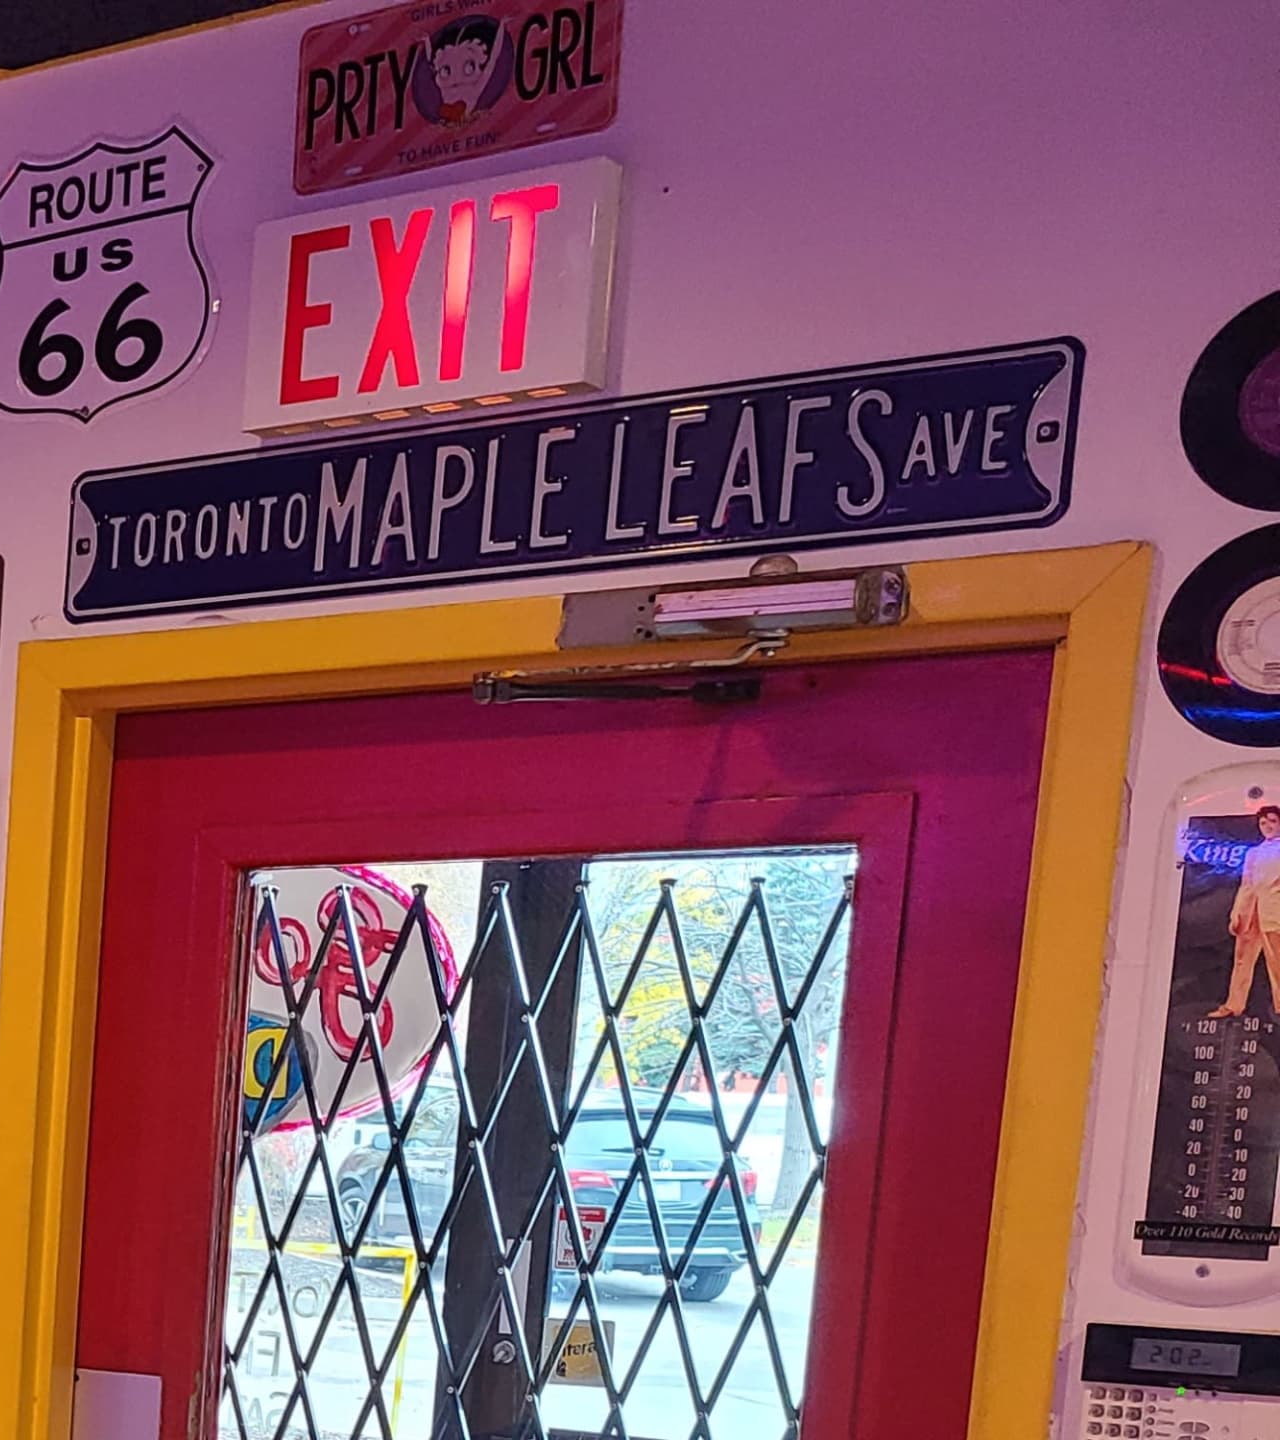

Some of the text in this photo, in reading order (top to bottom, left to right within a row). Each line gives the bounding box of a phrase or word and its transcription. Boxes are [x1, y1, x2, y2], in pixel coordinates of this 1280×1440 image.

[304, 2, 605, 150] PRTY GRL
[398, 150, 418, 163] TO
[422, 141, 460, 158] HAVE
[29, 155, 167, 228] ROUTE
[52, 238, 134, 282] US
[280, 183, 560, 405] EXIT
[19, 282, 164, 396] 66
[108, 388, 1013, 574] TORONTO MAPLE LEAFS AVE
[1198, 1021, 1217, 1033] 120
[1244, 1018, 1259, 1030] 50
[1194, 1047, 1214, 1059] 100
[1242, 1041, 1256, 1053] 40
[1240, 1064, 1253, 1077] 30
[1194, 1072, 1209, 1084] 80
[1237, 1086, 1251, 1099] 20
[1191, 1096, 1206, 1109] 60
[1236, 1108, 1248, 1120] 10
[1189, 1119, 1203, 1132] 40
[1234, 1129, 1241, 1141] 0
[1187, 1142, 1201, 1154] 20
[1188, 1164, 1195, 1176] 0
[1170, 1226, 1191, 1239] 110
[1194, 1226, 1228, 1242] Gold
